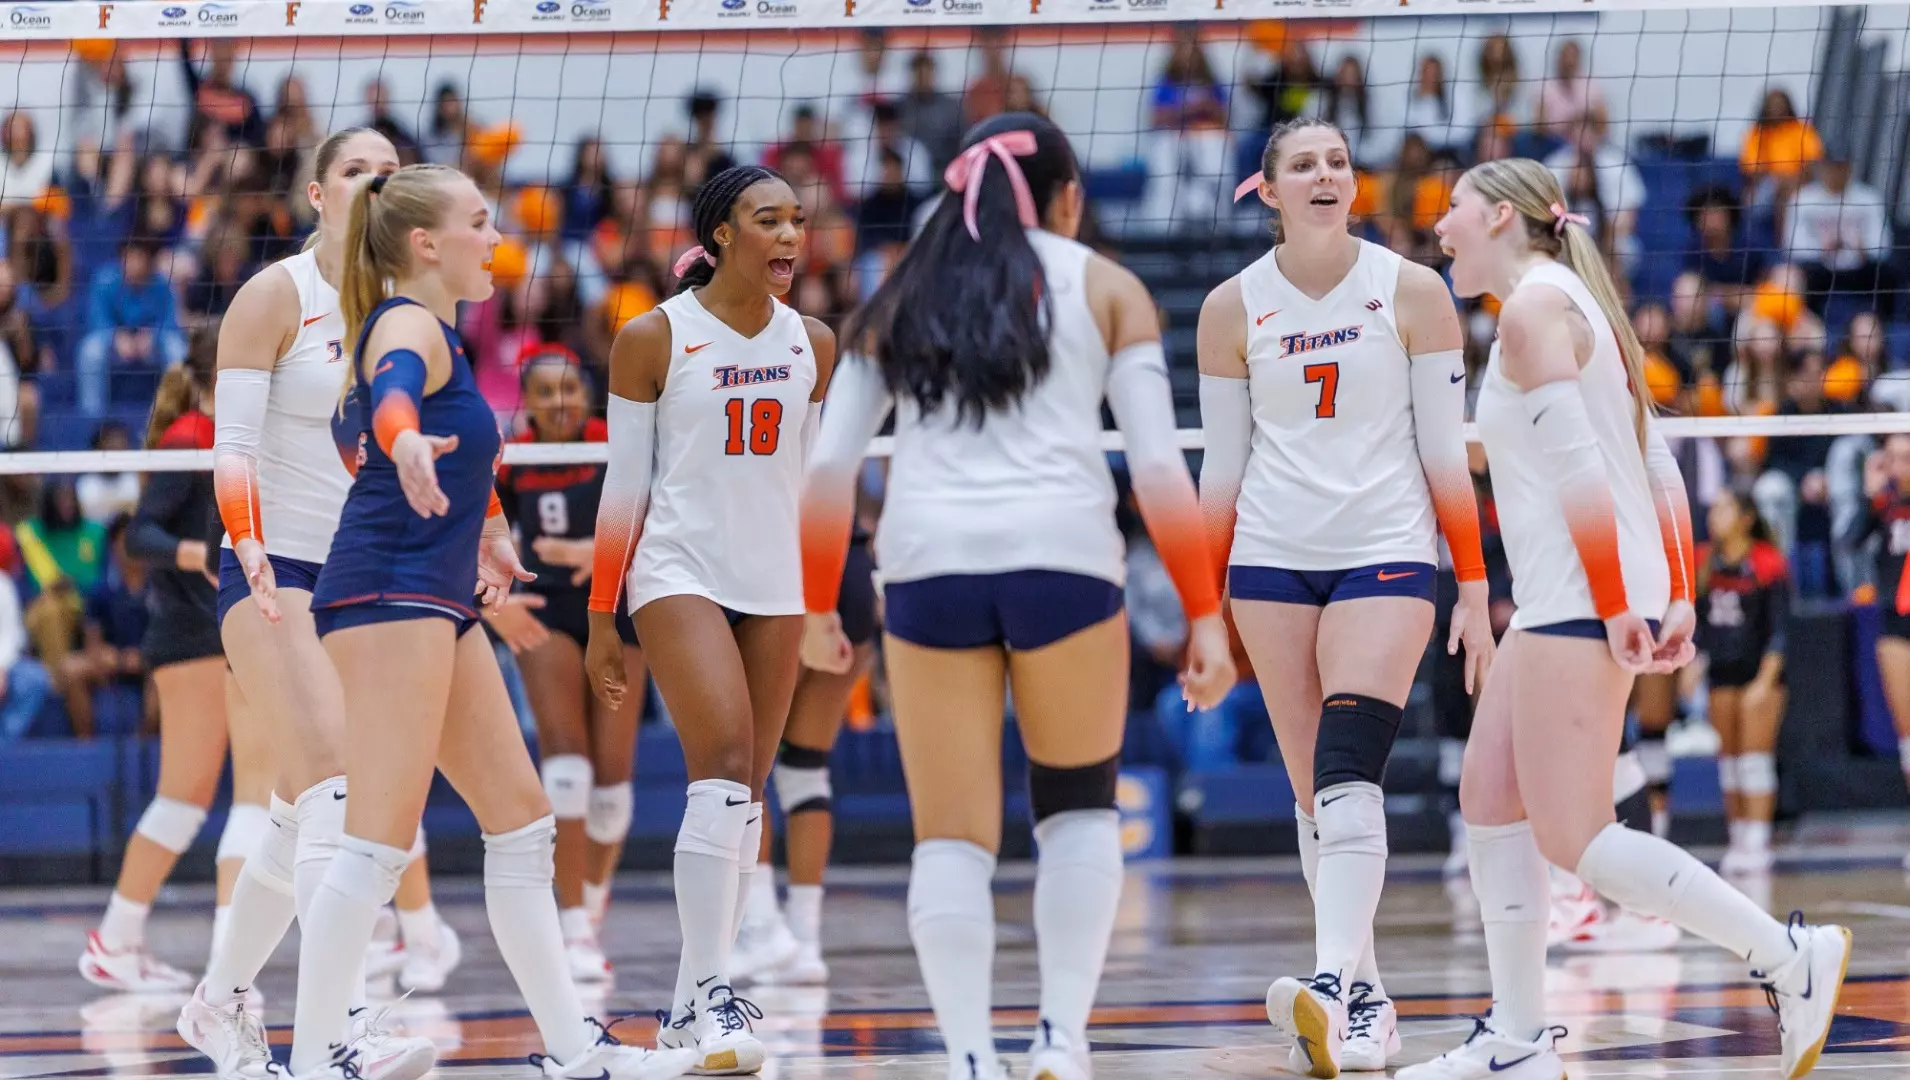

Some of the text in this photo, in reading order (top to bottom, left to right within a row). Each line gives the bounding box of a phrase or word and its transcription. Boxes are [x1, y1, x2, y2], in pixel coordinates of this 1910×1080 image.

[10, 12, 50, 24] Ocean
[98, 5, 114, 29] F
[197, 9, 238, 22] Ocean
[285, 2, 301, 26] F
[384, 7, 425, 20] Ocean
[472, 0, 488, 24] F
[571, 4, 611, 17] Ocean
[658, 0, 674, 20] F
[757, 1, 797, 13] Ocean
[1280, 326, 1362, 358] TITANS
[713, 364, 791, 389] TITANS
[1303, 361, 1340, 419] 7
[725, 398, 783, 456] 18
